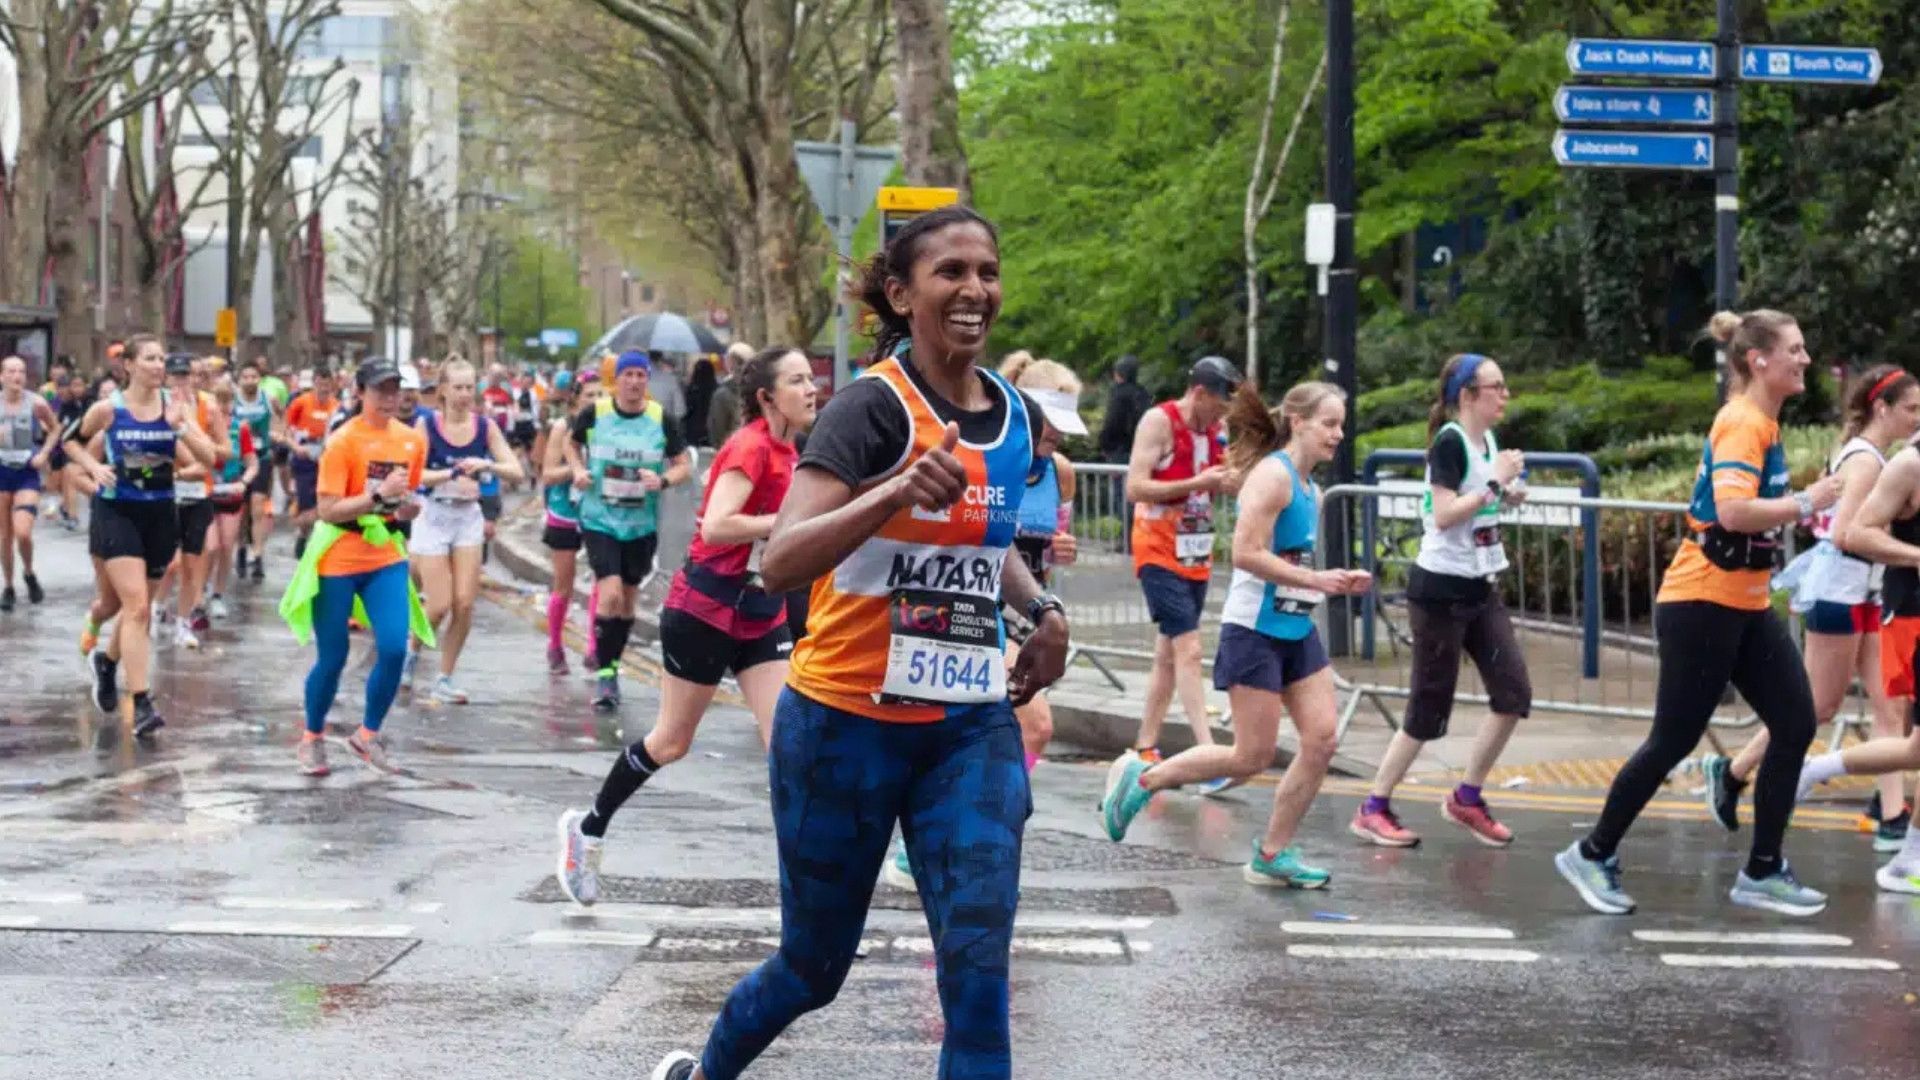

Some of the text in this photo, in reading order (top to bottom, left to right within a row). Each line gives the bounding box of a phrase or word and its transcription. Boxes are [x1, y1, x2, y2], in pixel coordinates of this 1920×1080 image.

[1584, 48, 1694, 65] Jack Dash House
[1794, 54, 1865, 74] South Quay
[1572, 97, 1641, 112] Idea store
[1572, 140, 1639, 156] Jobcentre
[963, 485, 1006, 506] CURE
[899, 597, 949, 633] tcs
[953, 602, 975, 614] TATA
[950, 625, 985, 638] SERVICES
[908, 649, 990, 693] 51644
